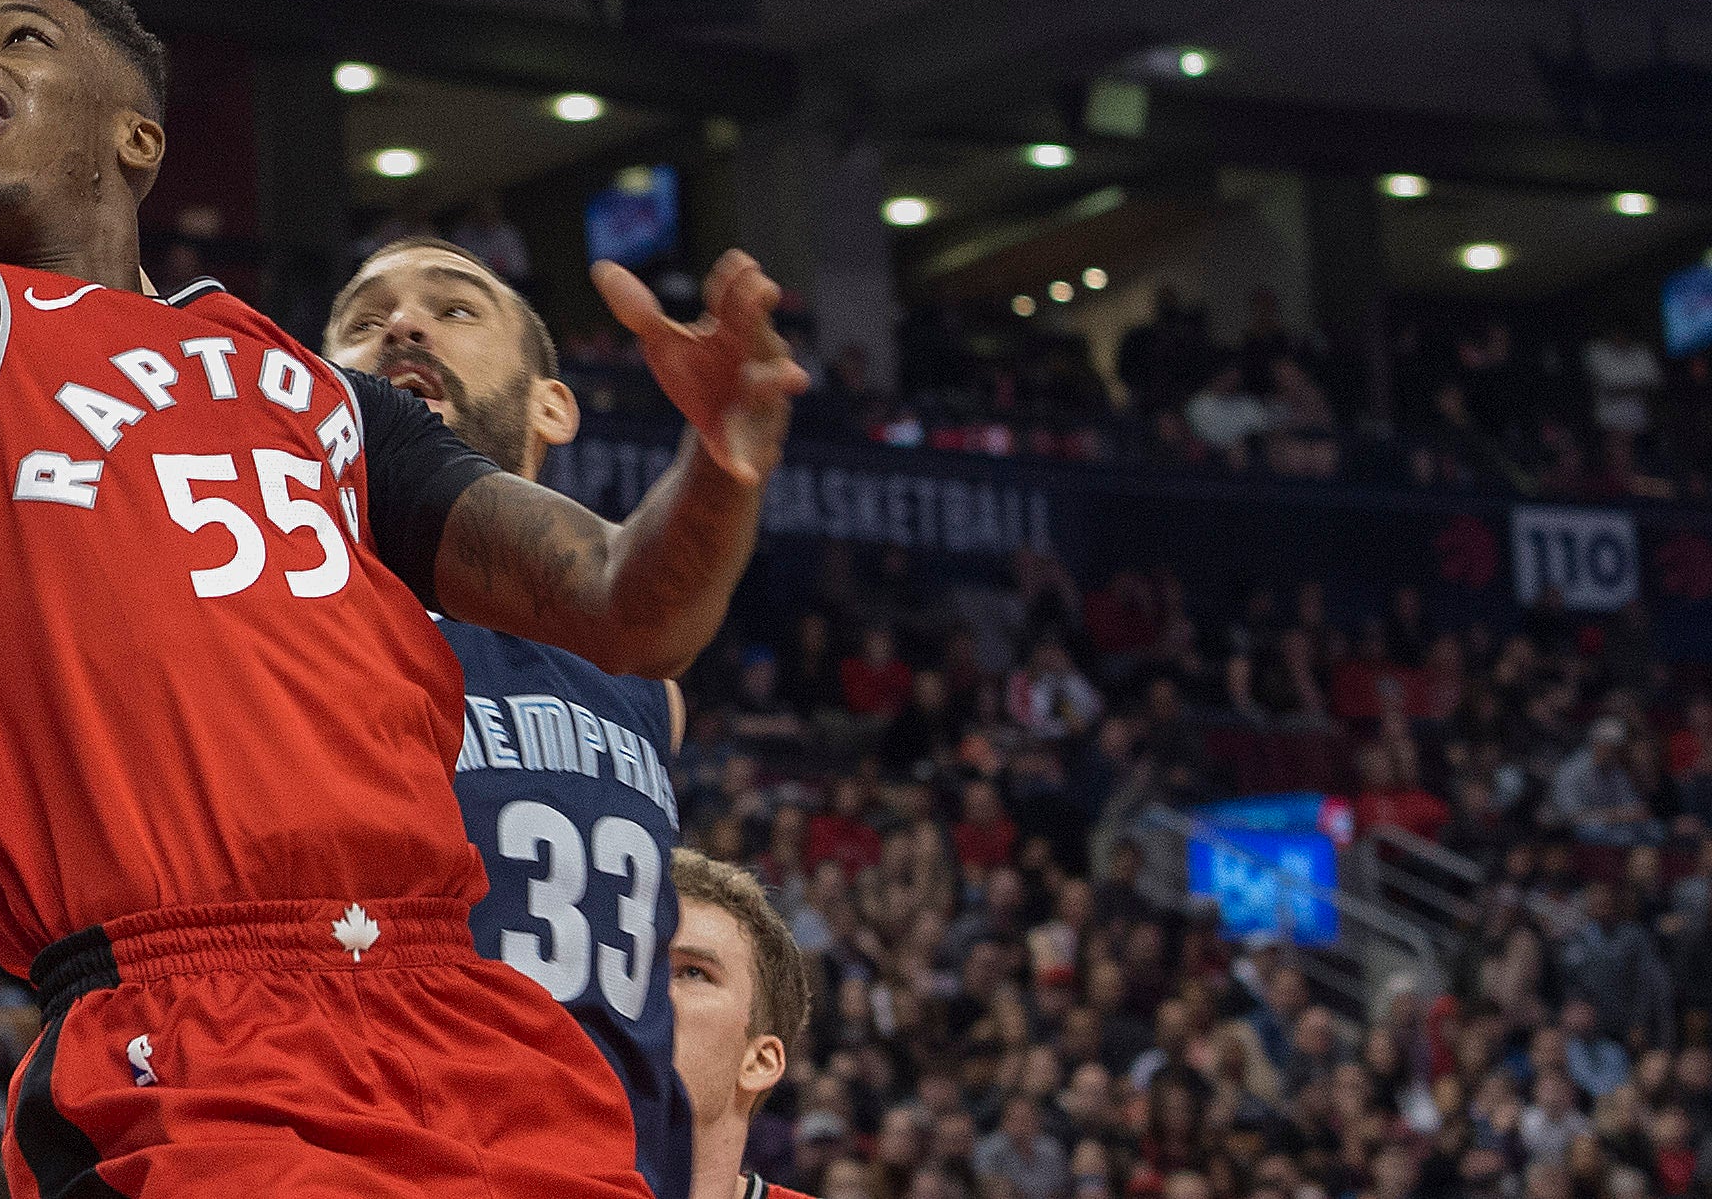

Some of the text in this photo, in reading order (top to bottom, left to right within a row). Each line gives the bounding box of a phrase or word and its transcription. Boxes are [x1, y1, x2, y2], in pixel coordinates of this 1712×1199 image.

[151, 448, 350, 599] 55
[1528, 529, 1626, 590] 110
[496, 800, 663, 1022] 33
